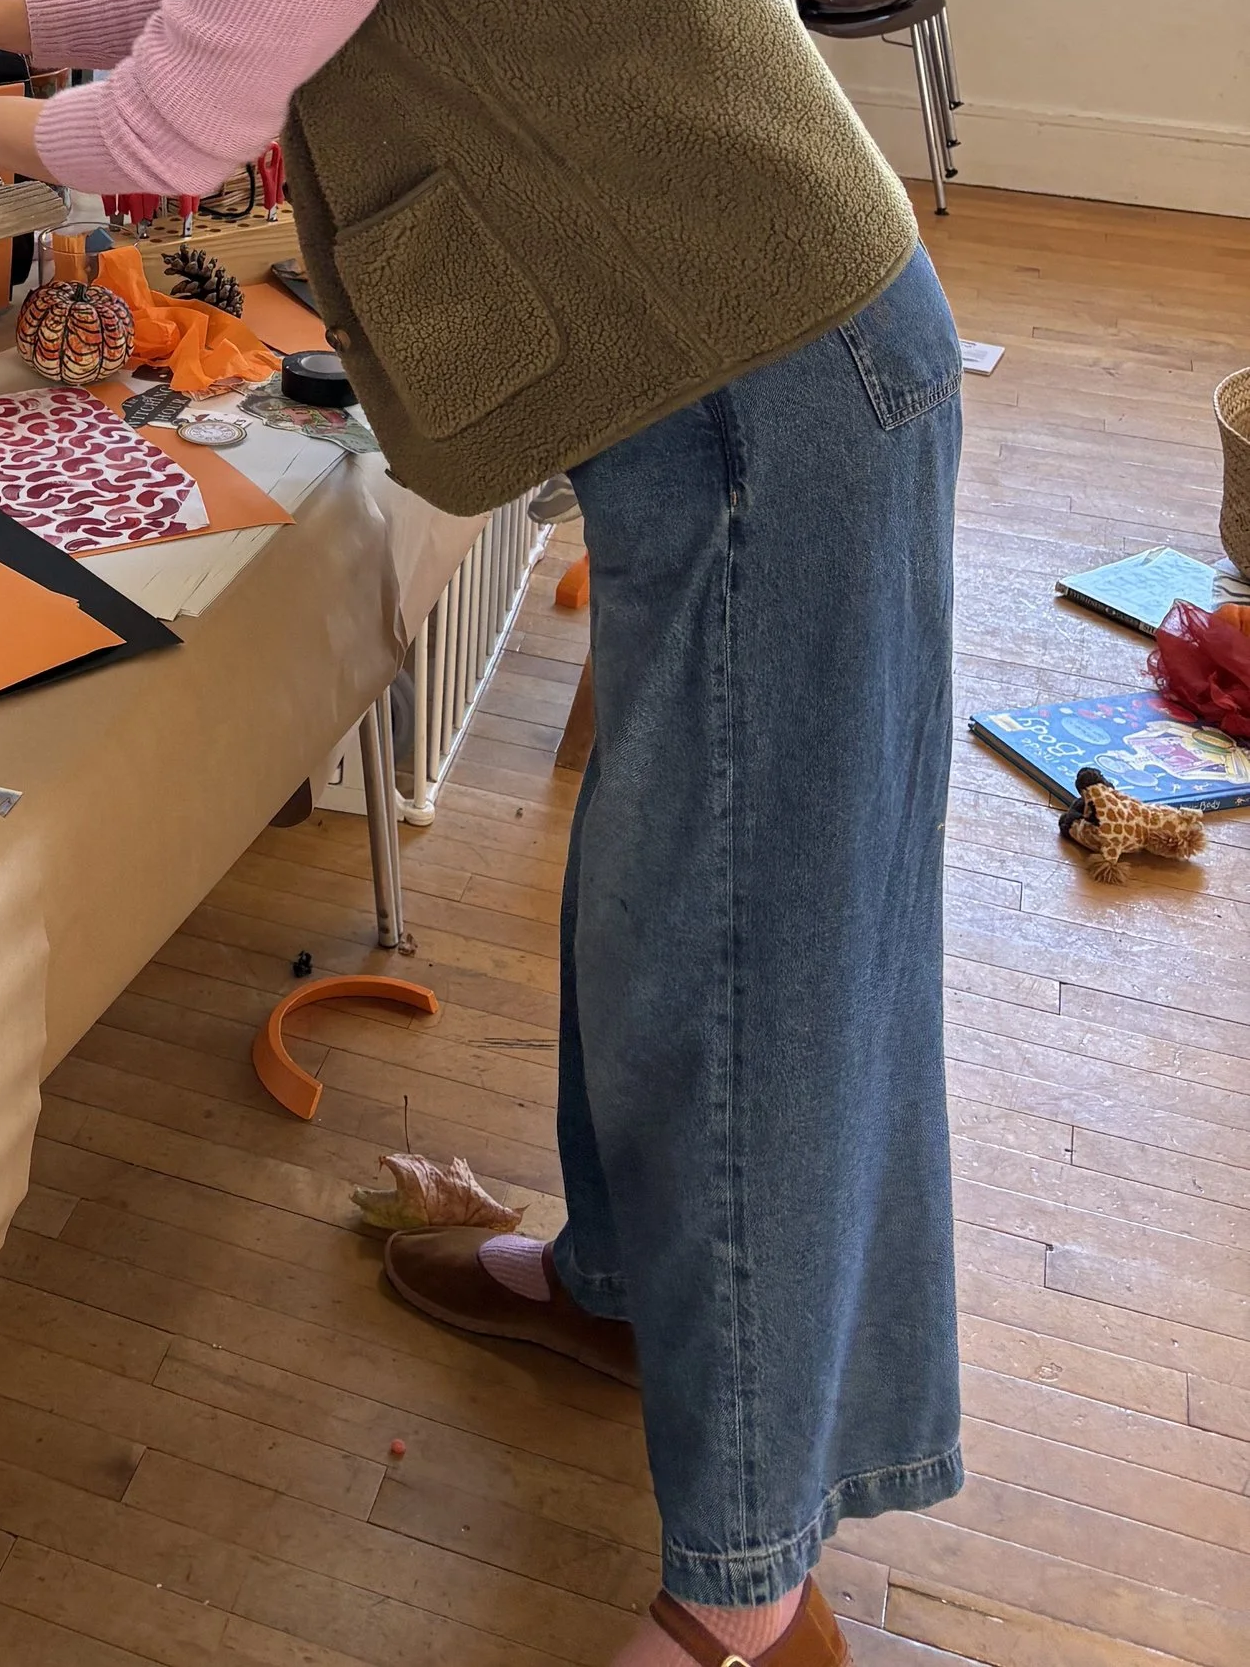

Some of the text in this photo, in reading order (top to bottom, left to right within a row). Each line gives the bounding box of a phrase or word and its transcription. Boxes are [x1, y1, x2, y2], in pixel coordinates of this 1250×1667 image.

[154, 398, 188, 421] HOUR
[1016, 717, 1087, 757] Body
[1199, 799, 1221, 811] Body
